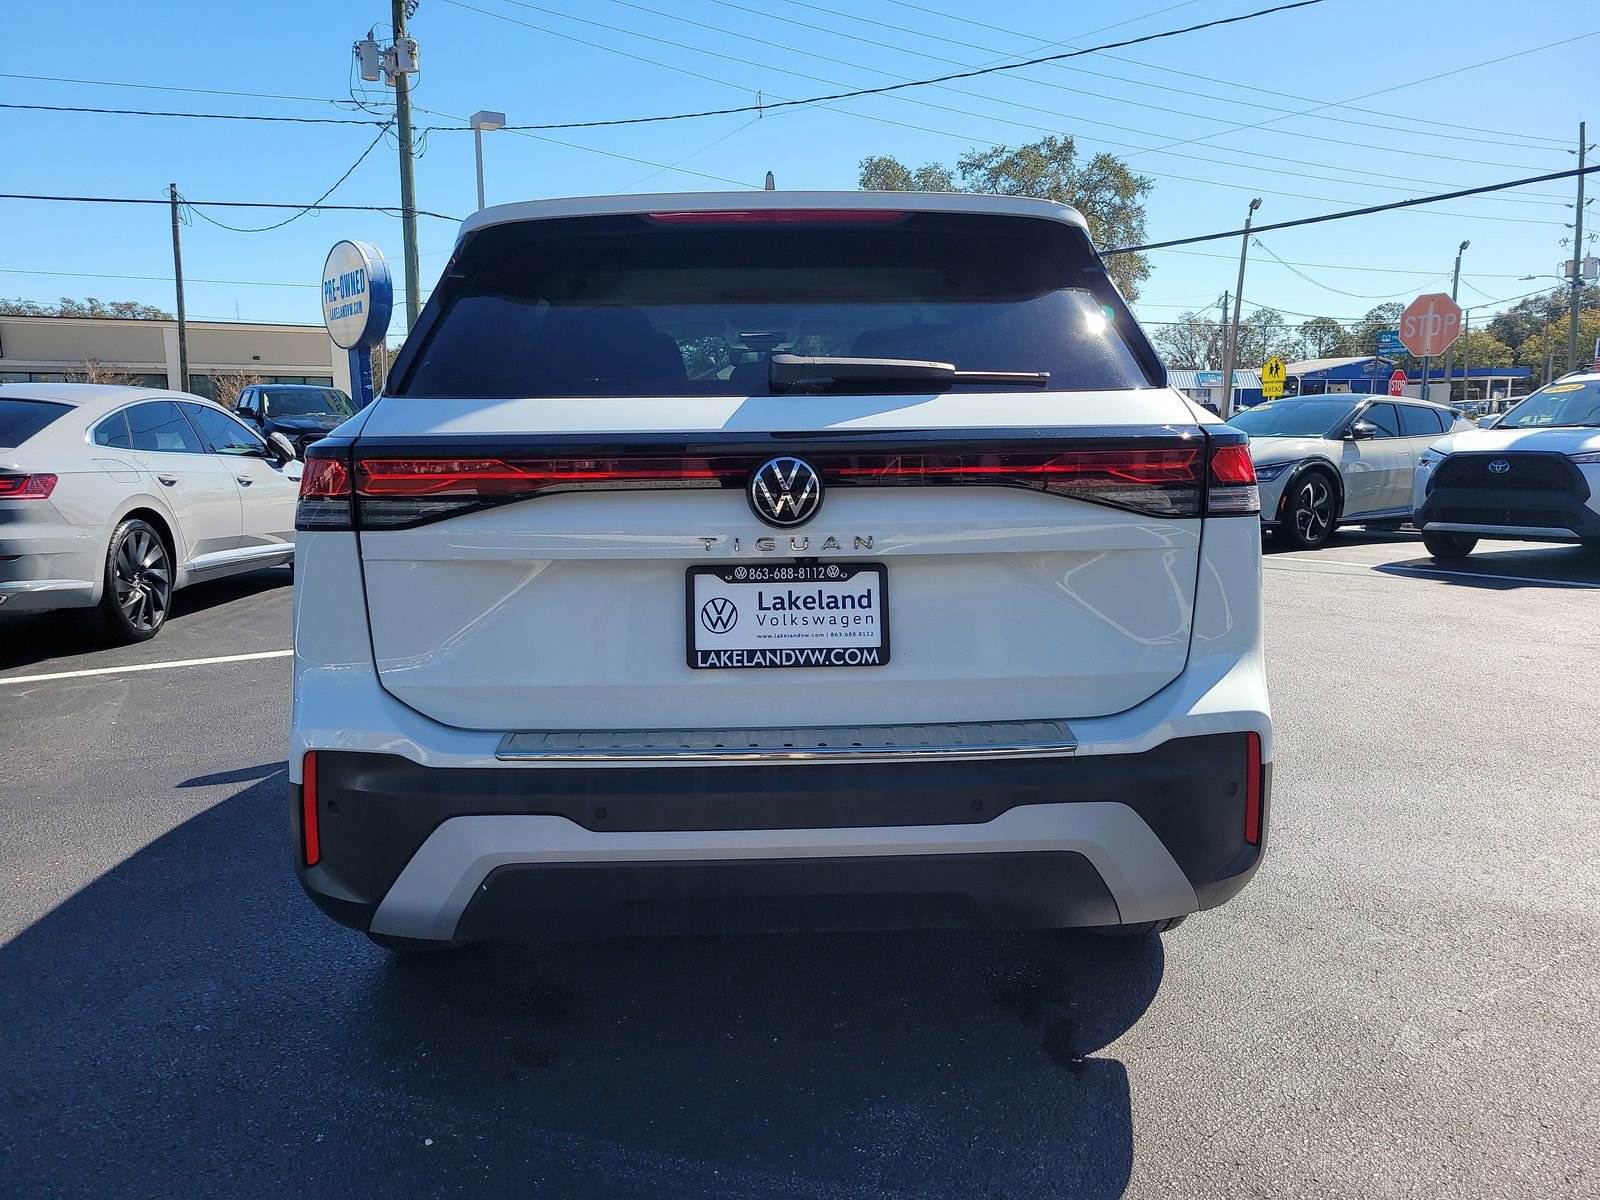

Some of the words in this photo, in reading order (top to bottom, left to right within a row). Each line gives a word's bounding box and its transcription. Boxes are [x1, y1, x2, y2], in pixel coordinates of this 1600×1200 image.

[324, 268, 365, 304] PRE-OWNED
[1404, 313, 1456, 337] STOP
[1391, 379, 1406, 391] STOP
[698, 535, 875, 552] TIGUAN
[748, 567, 825, 580] 863-688-8112
[757, 588, 873, 611] Lakeland
[756, 613, 874, 628] Volkswagen
[697, 648, 880, 668] LAKELANDVW.COM
